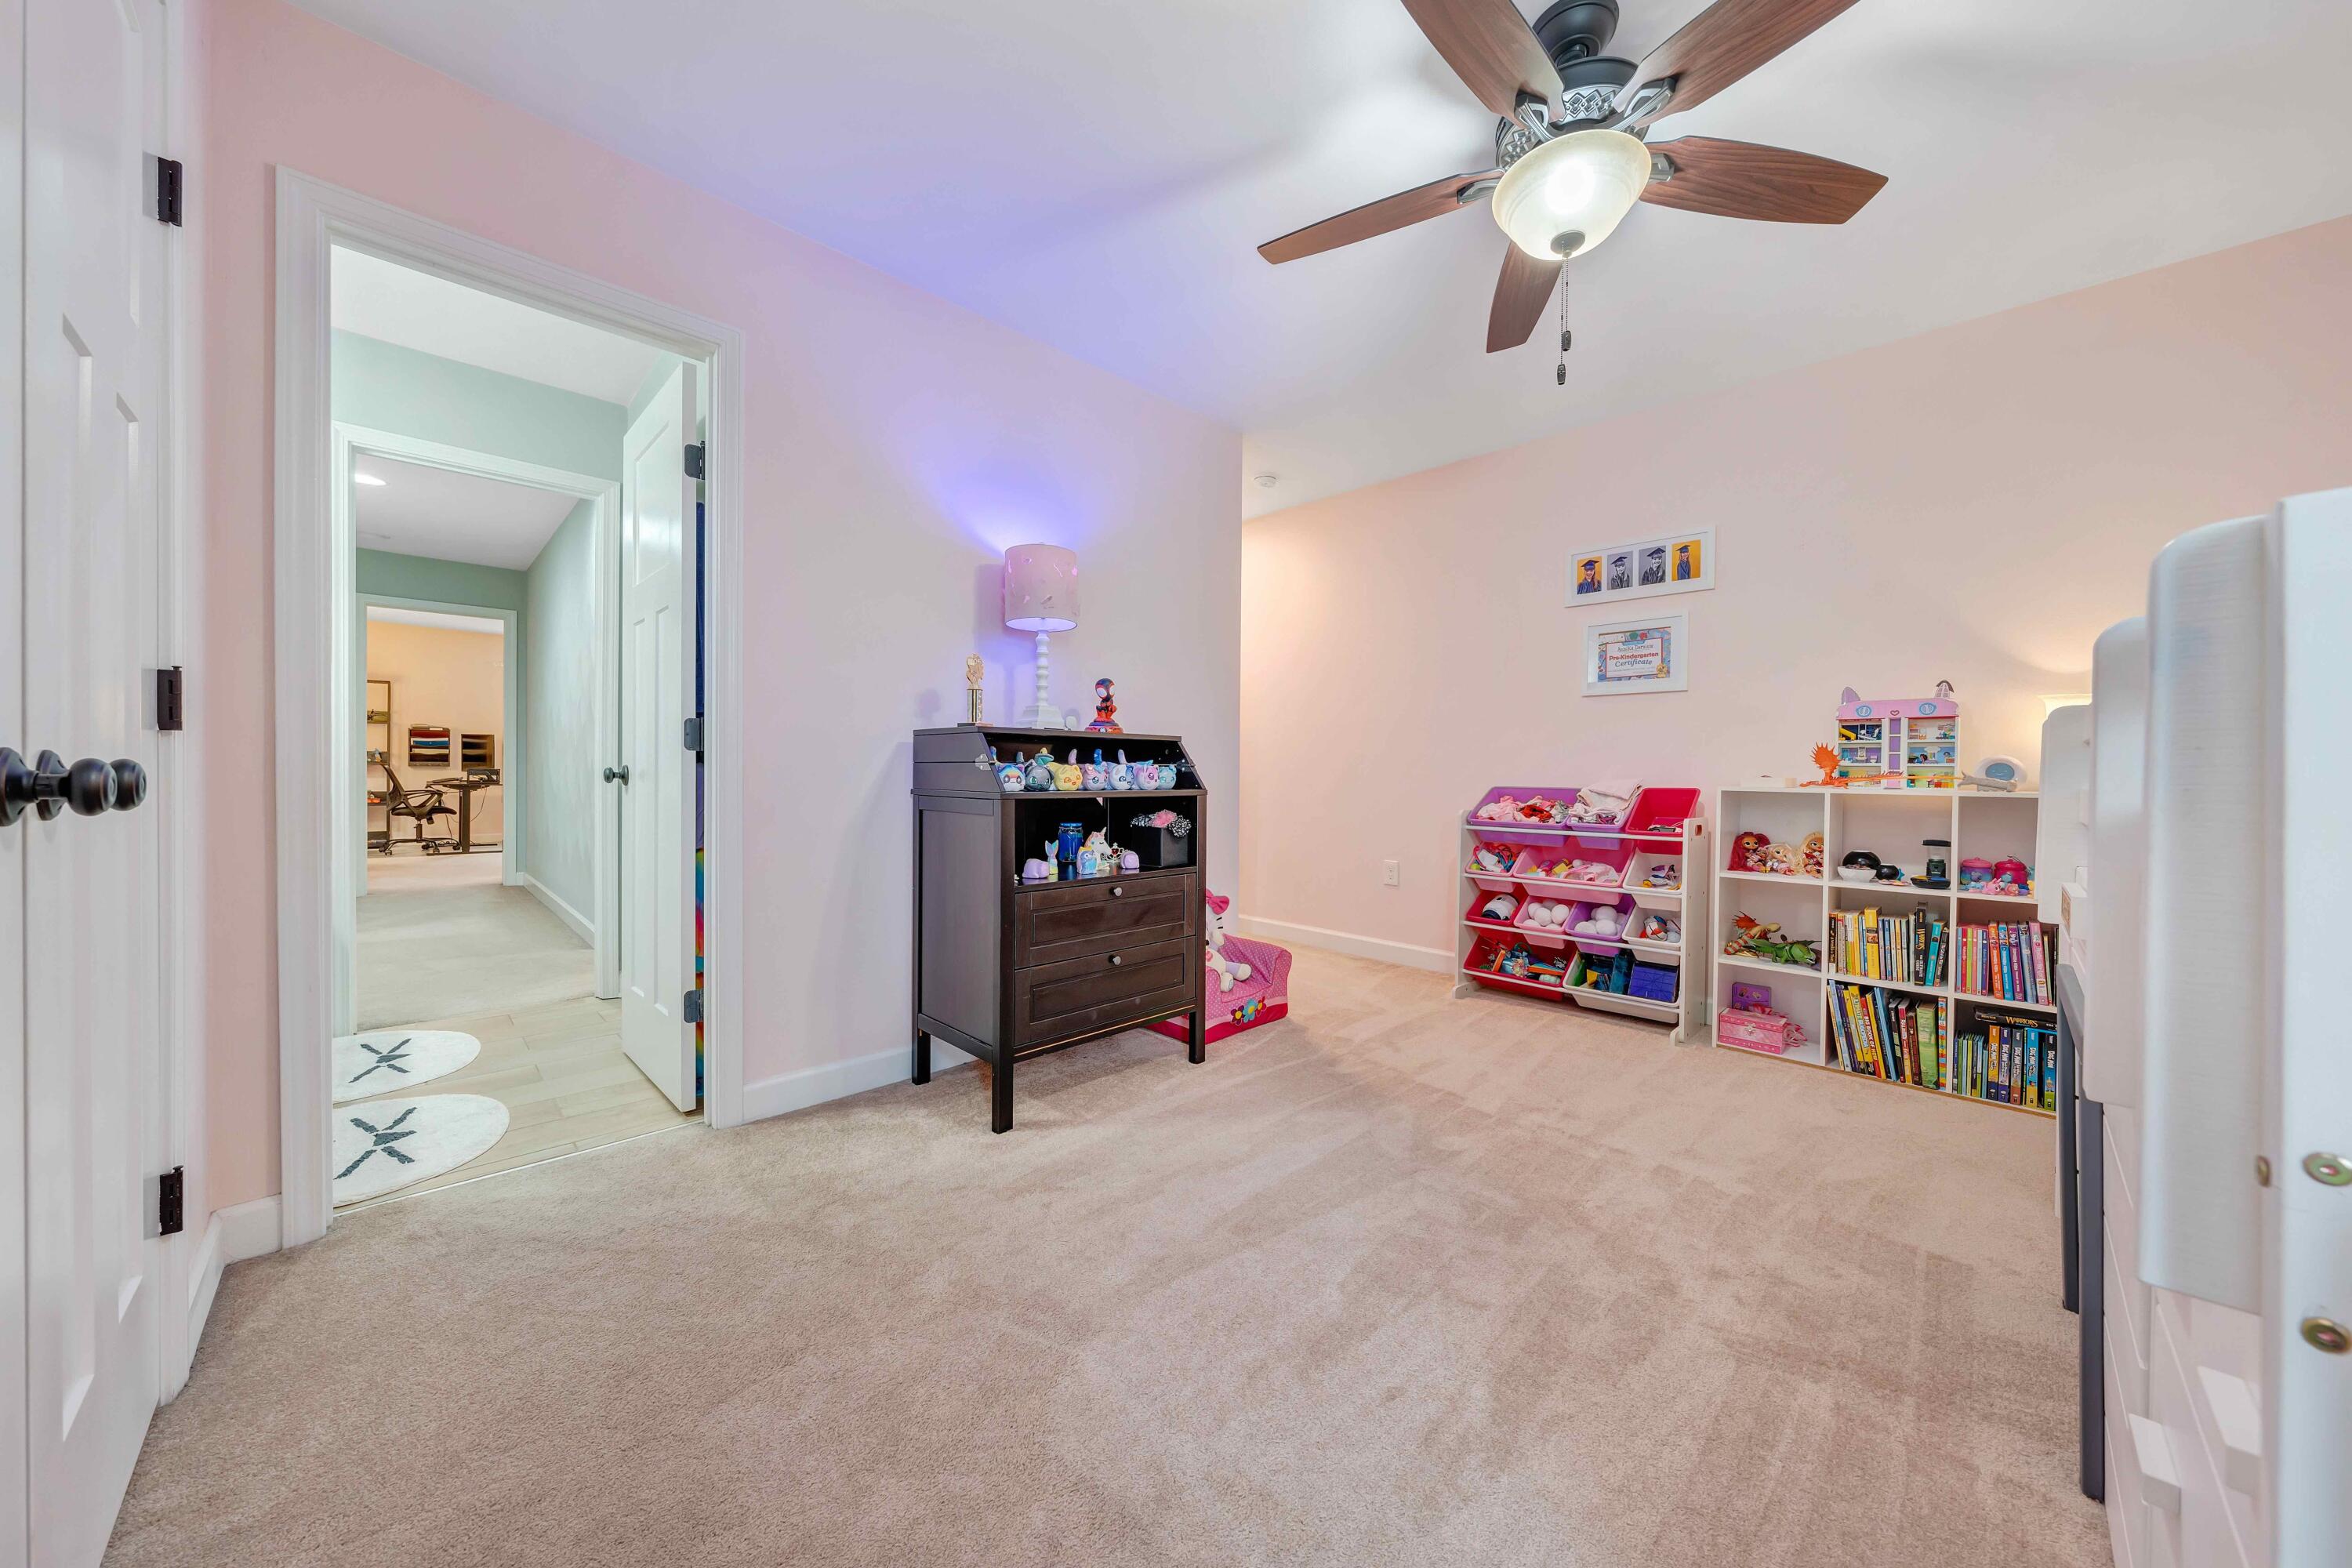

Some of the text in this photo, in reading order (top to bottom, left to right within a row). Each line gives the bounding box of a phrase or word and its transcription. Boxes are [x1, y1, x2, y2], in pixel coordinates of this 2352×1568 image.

[1615, 659, 1653, 667] Certificate
[1915, 928, 1926, 950] WARRIORS
[2005, 1016, 2038, 1029] WARRIORS
[1870, 1040, 1875, 1049] OF
